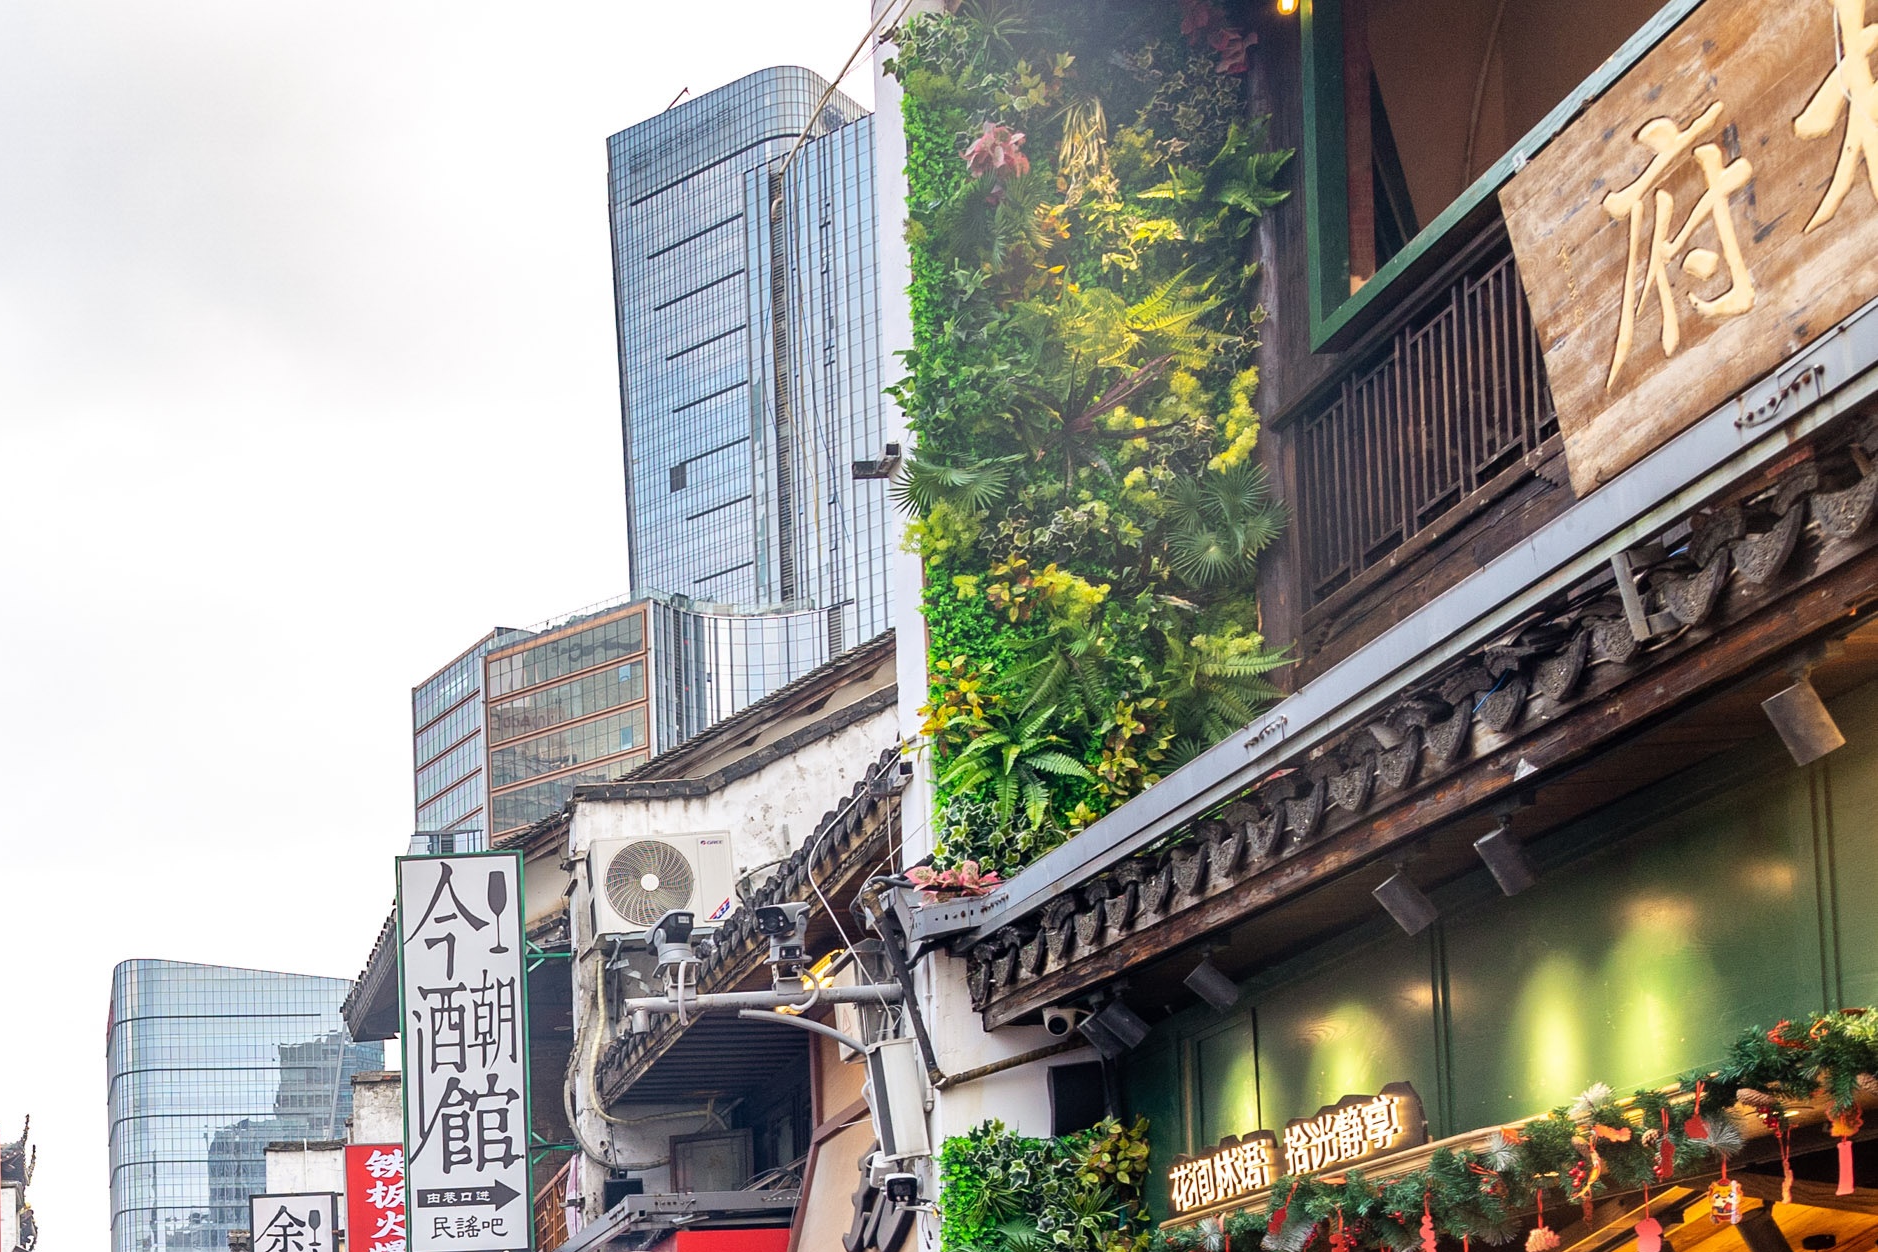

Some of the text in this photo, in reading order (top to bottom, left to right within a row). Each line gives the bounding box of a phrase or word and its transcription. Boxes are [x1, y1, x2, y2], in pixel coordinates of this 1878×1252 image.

[1284, 1094, 1403, 1176] 拾光静享
[1169, 1137, 1270, 1212] 花间林语
